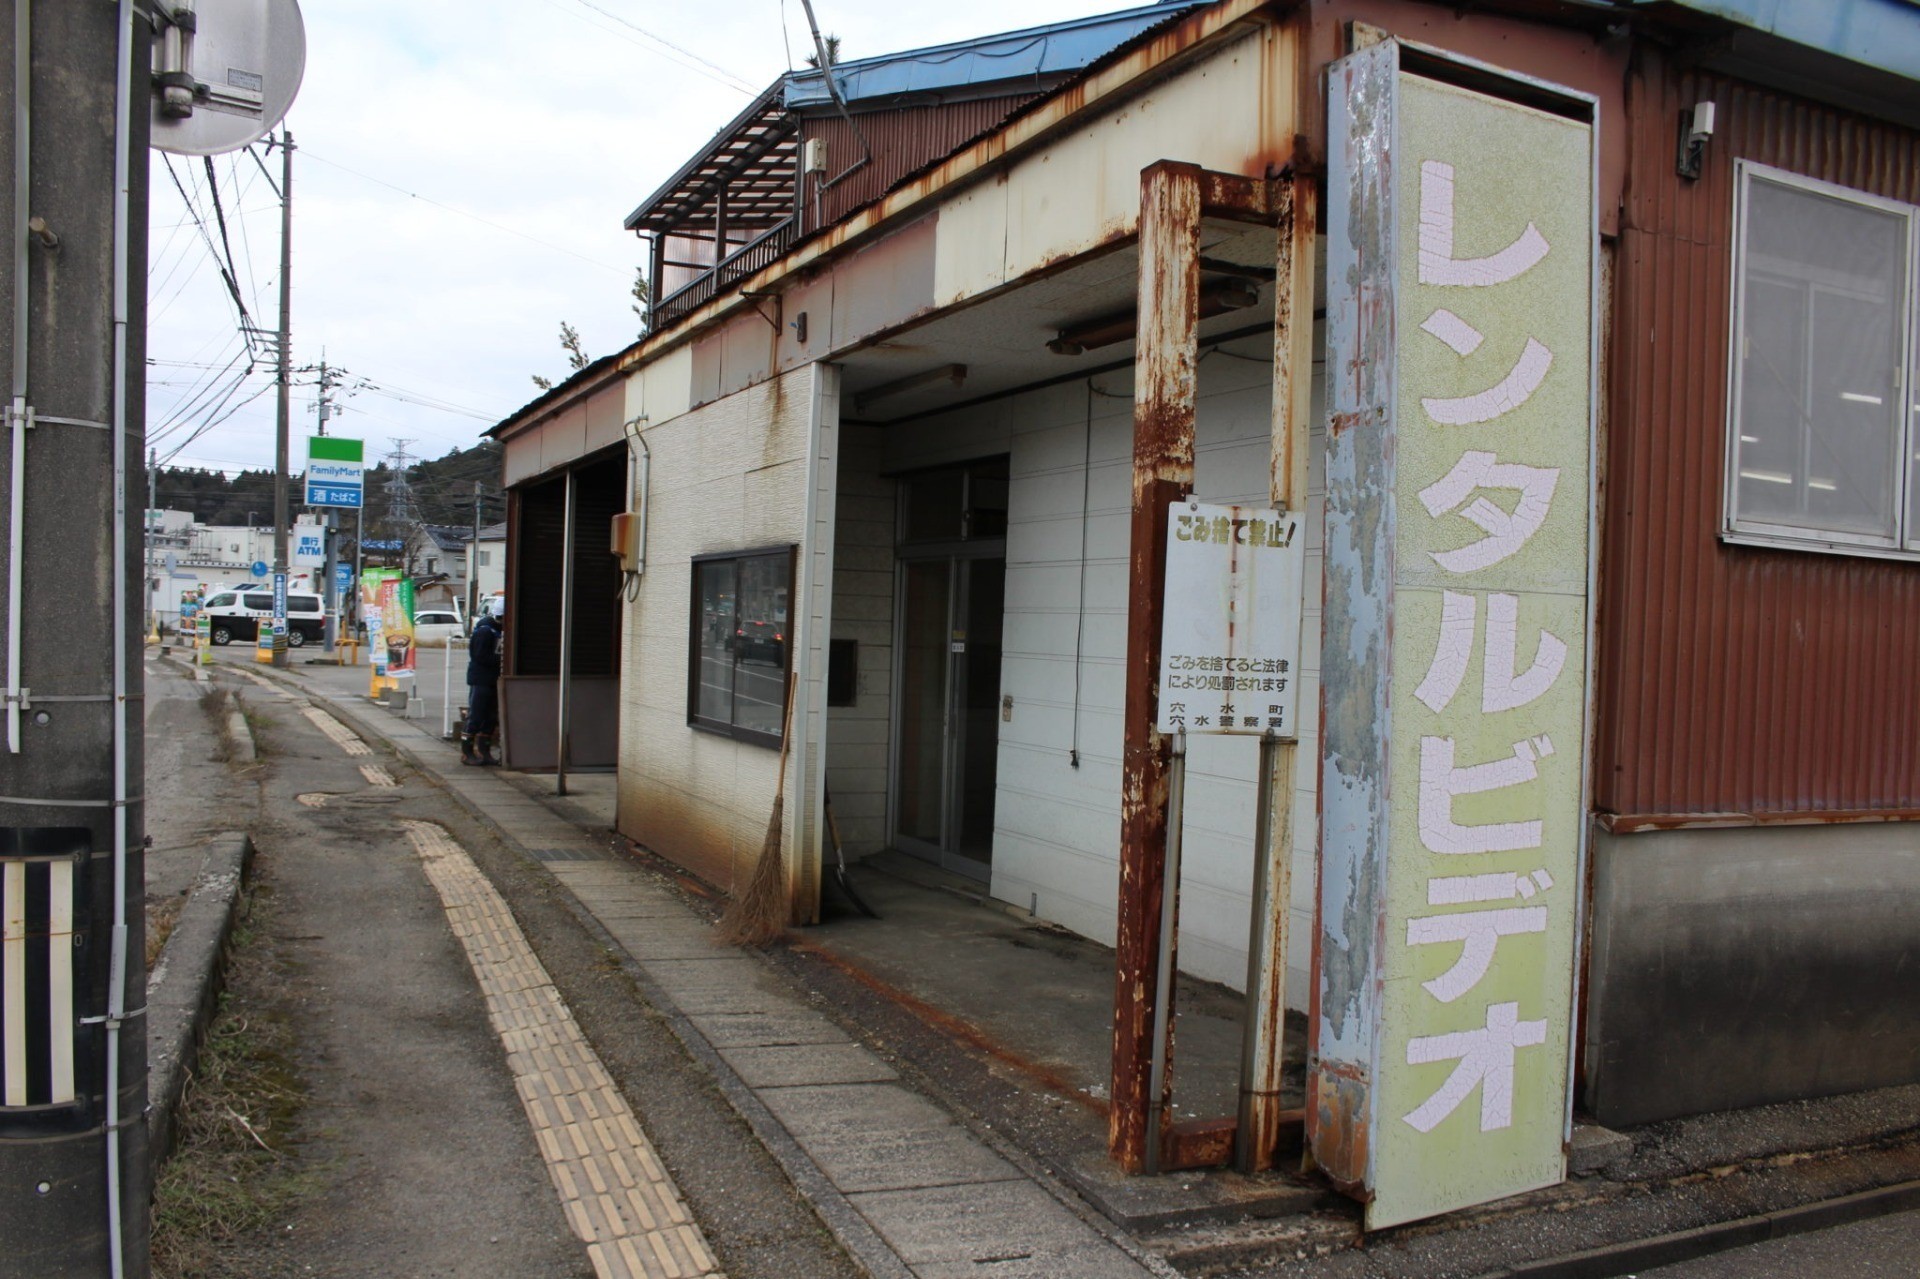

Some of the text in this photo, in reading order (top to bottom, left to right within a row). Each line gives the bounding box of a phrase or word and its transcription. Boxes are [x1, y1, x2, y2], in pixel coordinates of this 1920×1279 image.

[310, 464, 361, 477] FamilyMart
[313, 489, 357, 503] 酒 たばこ
[297, 546, 321, 556] ATM
[1402, 158, 1569, 1134] レンタルビデオ
[1168, 654, 1289, 674] ごみを捨てると法律
[1168, 674, 1288, 693] により処罰されます
